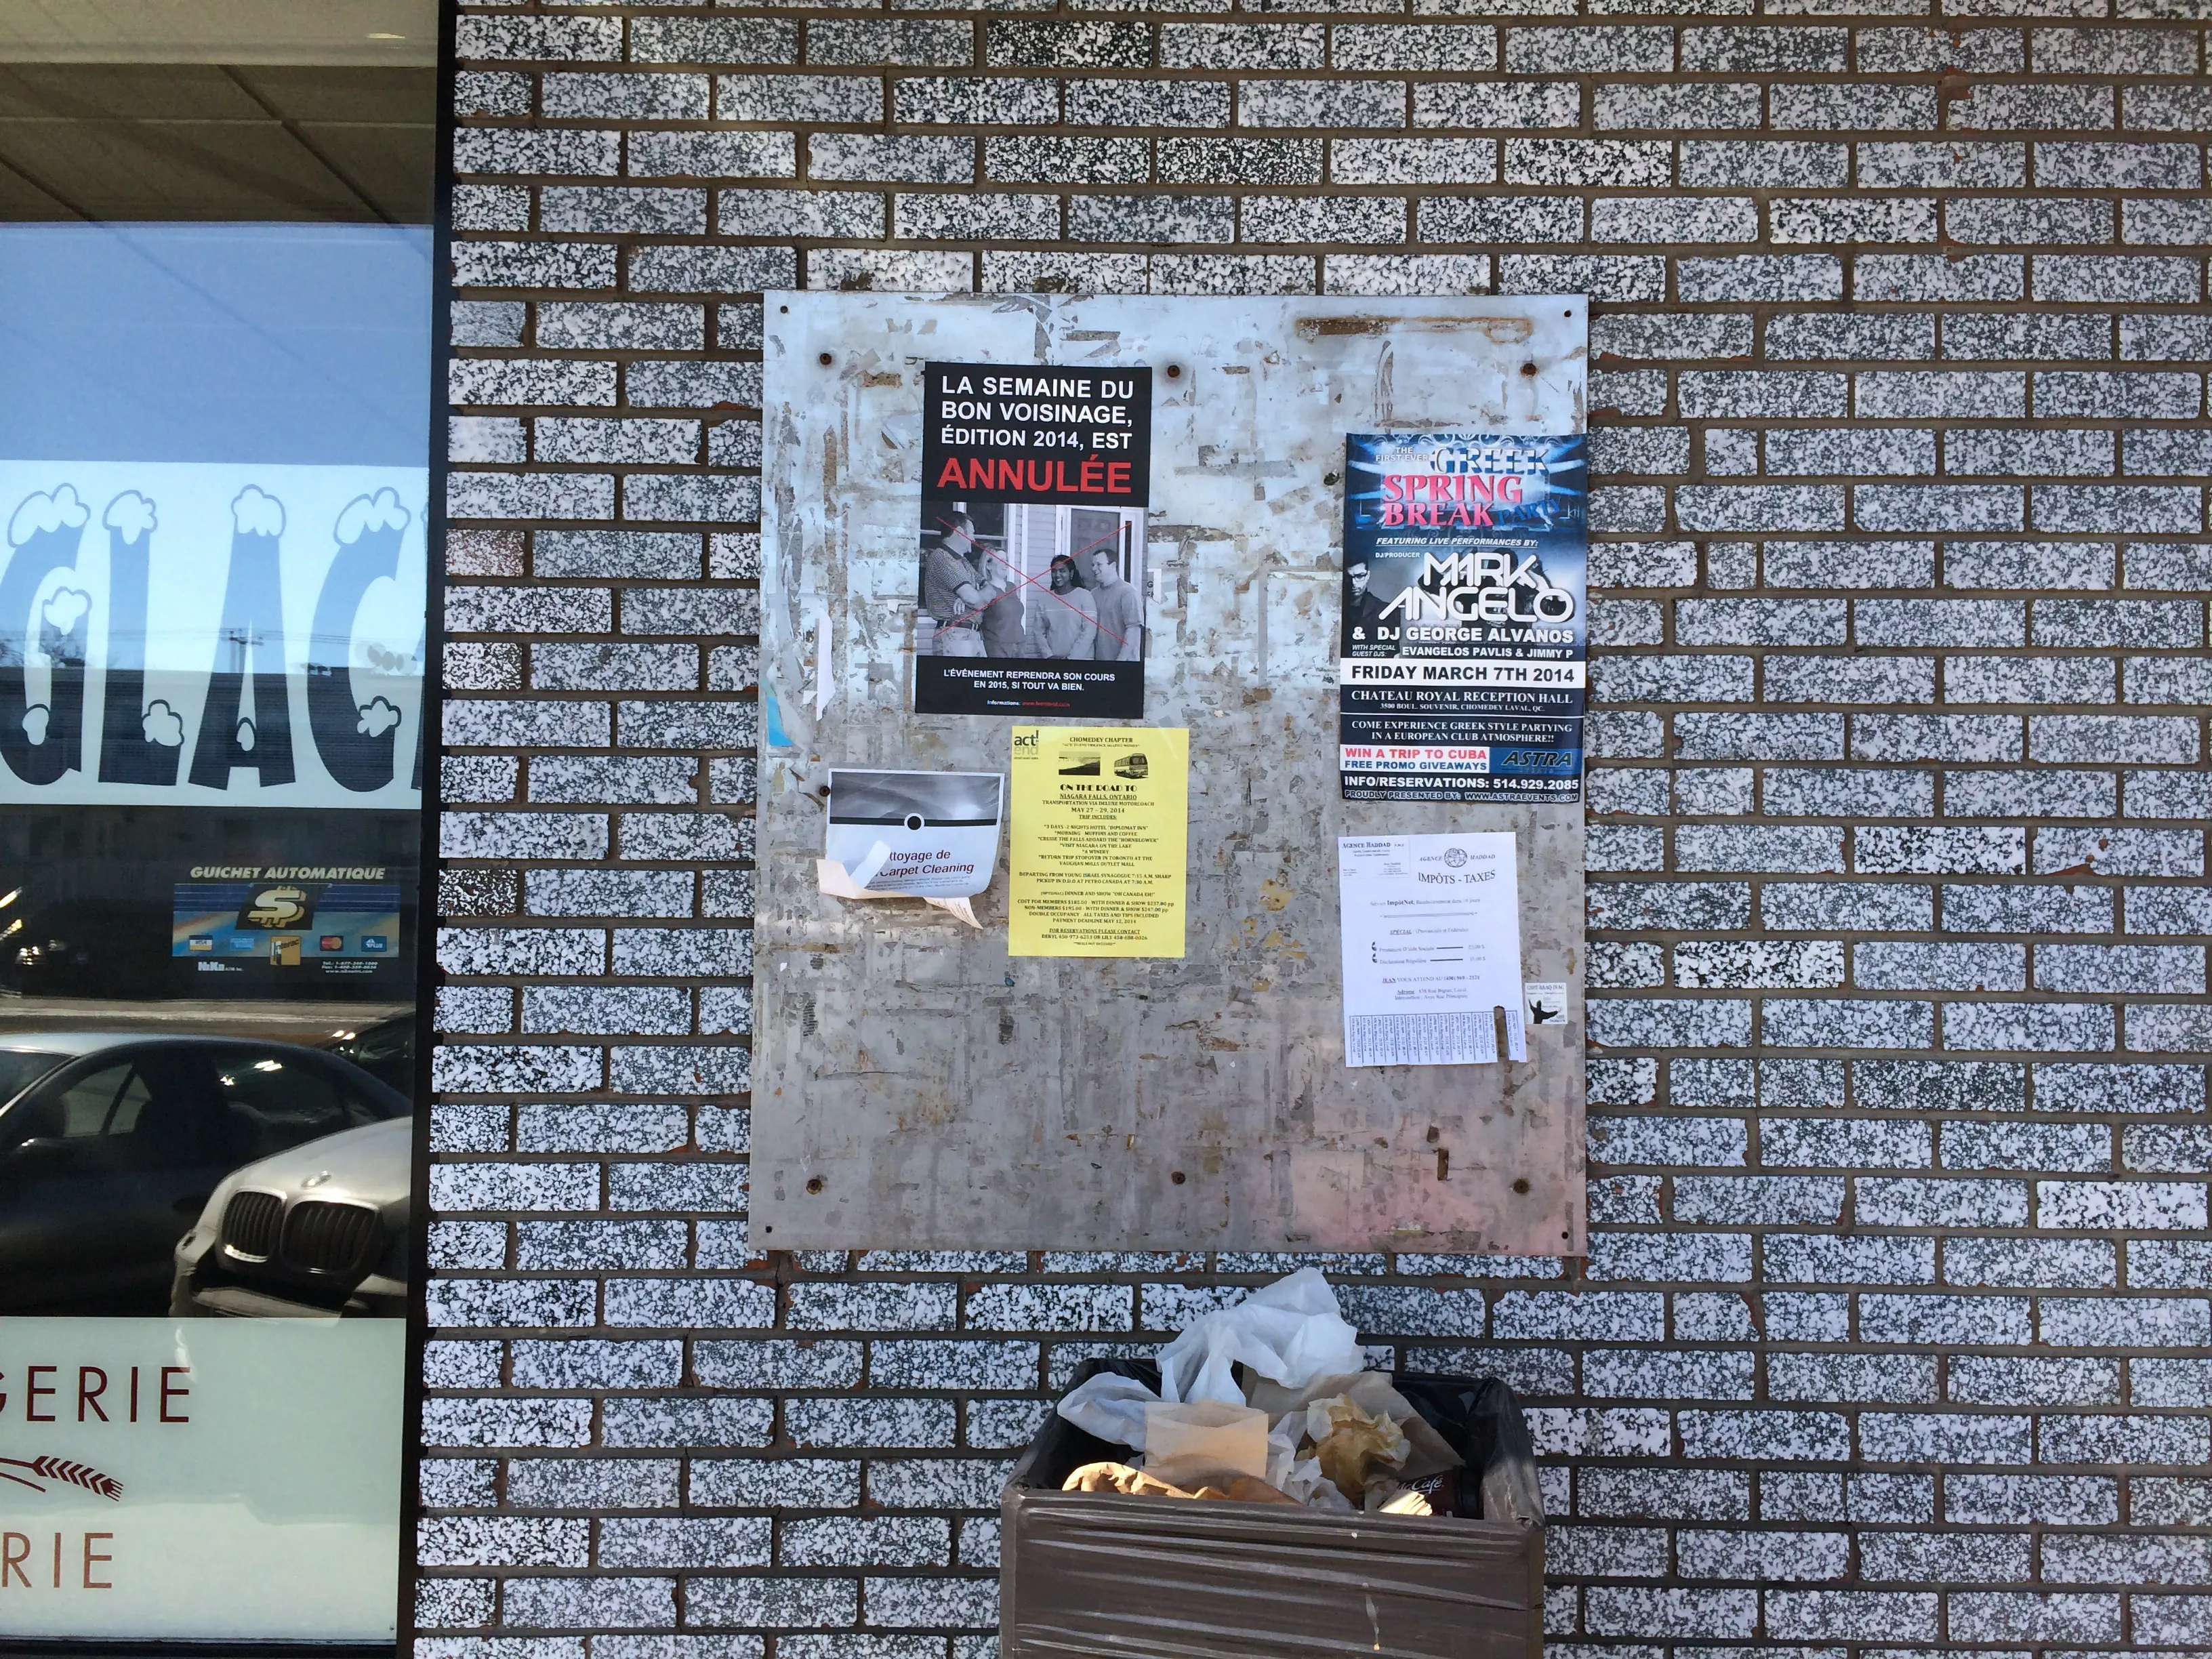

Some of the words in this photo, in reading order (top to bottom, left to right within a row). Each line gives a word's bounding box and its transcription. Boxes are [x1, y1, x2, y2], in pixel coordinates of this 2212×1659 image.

[943, 376, 973, 394] LA
[983, 377, 1090, 398] SEMAINE
[1101, 381, 1133, 398] DU
[942, 401, 991, 419] BON
[1000, 403, 1132, 427] VOISINAGE,
[942, 424, 1025, 446] ÉDITION
[1033, 431, 1084, 451] 2014,
[1092, 432, 1132, 449] EST
[1431, 447, 1550, 475] GREEK
[938, 453, 1132, 493] ANNULÉE
[1382, 474, 1522, 504] SPRING
[1384, 502, 1494, 526] BREAK
[1497, 498, 1561, 525] PARTY
[1424, 552, 1538, 588] MARK
[1378, 587, 1575, 622] ANGELO
[0, 482, 427, 792] GLAC
[1352, 626, 1366, 640] &
[1378, 627, 1400, 640] DJ
[1406, 627, 1482, 641] GEORGE
[1488, 628, 1574, 643] ALVANOS
[1402, 647, 1469, 657] EVANGELOS
[1473, 648, 1512, 657] PAVLIS
[1515, 649, 1523, 657] &
[1526, 649, 1562, 658] JIMMY
[1565, 650, 1573, 659] P
[944, 668, 1004, 678] L'ÉVÉNEMENT
[1006, 671, 1061, 680] REPRENDRA
[1084, 673, 1115, 681] COURS
[1352, 665, 1417, 679] FRIDAY
[1423, 667, 1487, 680] MARCH
[1494, 668, 1526, 681] 7TH
[1533, 668, 1574, 682] 2014
[988, 681, 1009, 689] 2015,
[1351, 691, 1412, 700] CHATEAU
[1416, 691, 1460, 701] ROYAL
[1464, 692, 1535, 702] RECEPTION
[1539, 693, 1572, 703] HALL
[1385, 721, 1448, 729] EXPERIENCE
[1450, 722, 1486, 730] GREEK
[1488, 722, 1519, 731] STYLE
[1521, 724, 1572, 732] PARTYING
[1480, 733, 1554, 742] ATMOSPHERE!!
[1014, 743, 1038, 755] end
[1345, 748, 1371, 758] WIN
[1376, 749, 1385, 758] A
[1389, 749, 1420, 758] TRIP
[1425, 750, 1443, 758] TO
[1448, 750, 1486, 759] CUBA
[1345, 760, 1372, 769] FREE
[1420, 762, 1486, 770] GIVEAWAYS
[1502, 752, 1572, 766] ASTRA
[1345, 777, 1489, 787] INFO/RESERVATIONS:
[1493, 779, 1578, 790] 514.929.2085
[1389, 791, 1442, 799] PRESENTED
[1445, 792, 1461, 800] BY:
[1465, 792, 1578, 802] WWW.ASTRAEVENTS.COM
[937, 850, 950, 859] de
[190, 866, 260, 880] GUICHET
[264, 866, 386, 880] AUTOMATIQUE
[922, 863, 974, 874] Cleaning
[1418, 872, 1455, 884] IMPÔTS
[1464, 869, 1496, 884] TAXES
[1, 1532, 114, 1589] RIE
